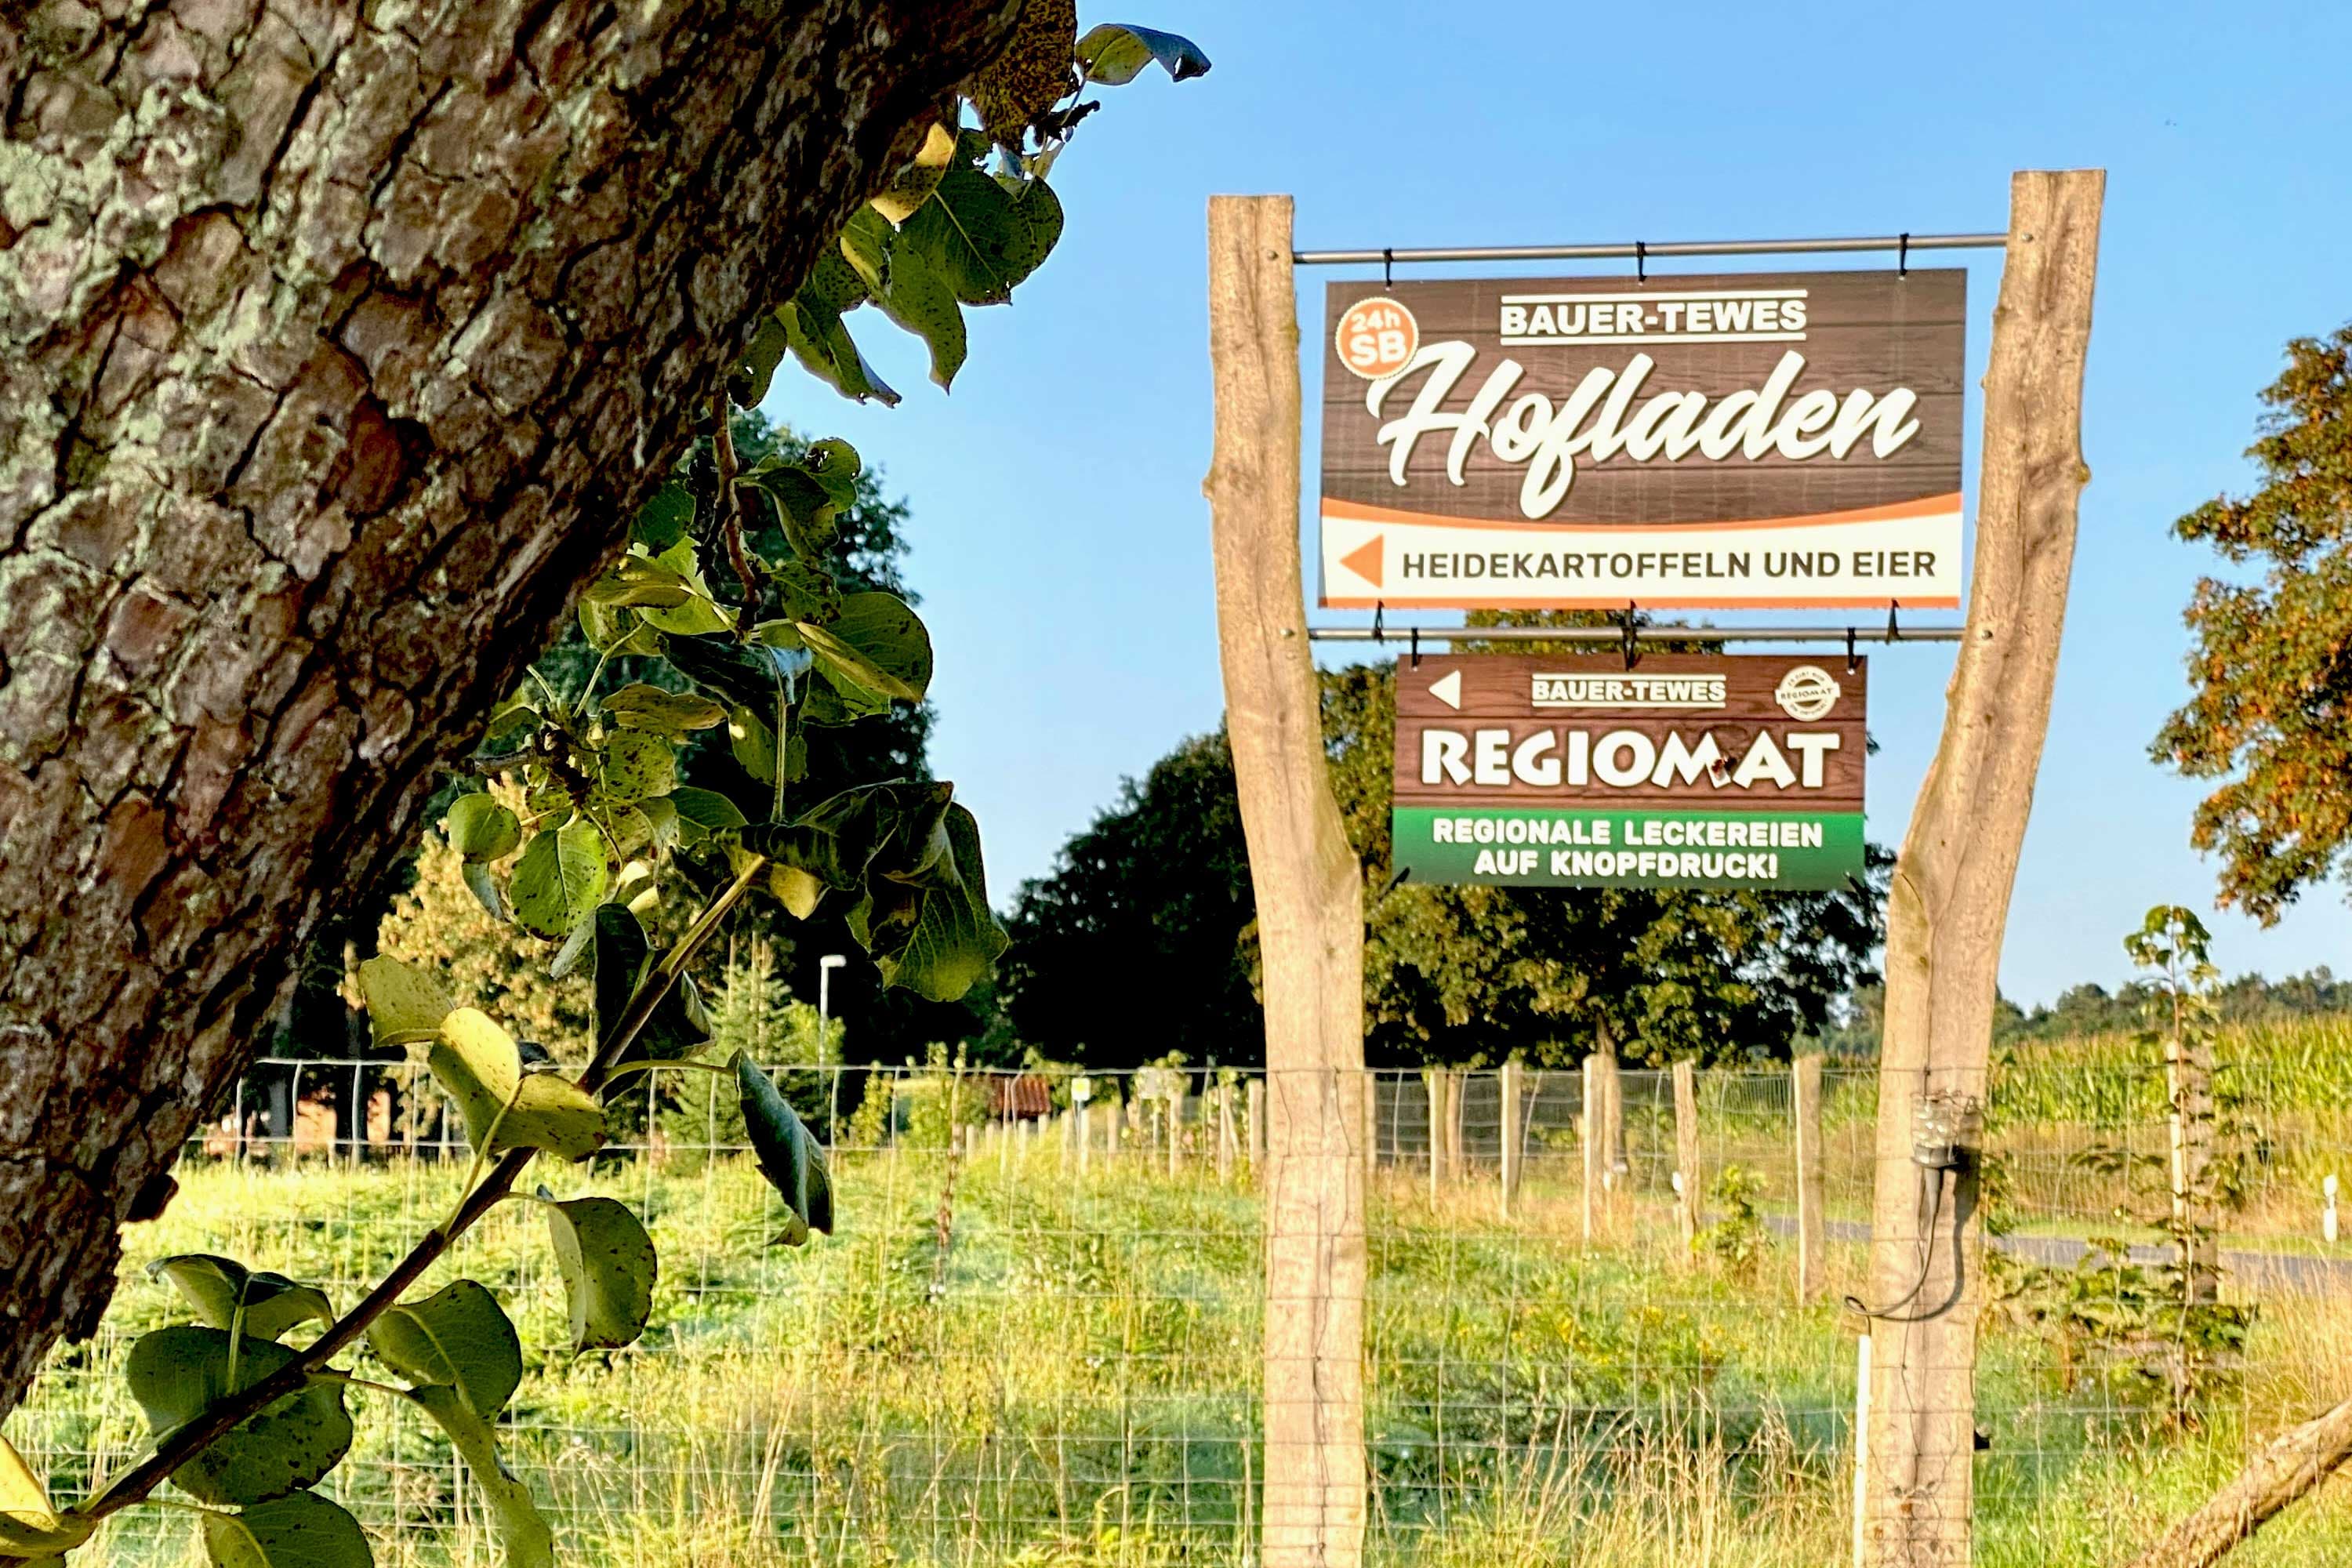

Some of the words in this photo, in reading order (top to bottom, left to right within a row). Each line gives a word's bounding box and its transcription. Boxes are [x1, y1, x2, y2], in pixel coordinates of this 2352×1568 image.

[1351, 309, 1400, 332] 24h
[1501, 300, 1806, 336] BAUER-TEWES
[1350, 330, 1407, 366] SB
[1367, 340, 1919, 518] Hofladen
[1403, 552, 1751, 579] HEIDEKARTOFFELN
[1764, 551, 1840, 577] UND
[1852, 550, 1936, 577] EIER
[1532, 681, 1726, 702] BAUER-TEWES
[1780, 688, 1833, 700] REGIOMAT
[1421, 730, 1839, 789] REGIOMAT
[1433, 818, 1611, 845] REGIONALE
[1625, 820, 1823, 848] LECKEREIEN
[1474, 851, 1537, 876] AUF
[1551, 851, 1778, 879] KNOPFDRUCK!
